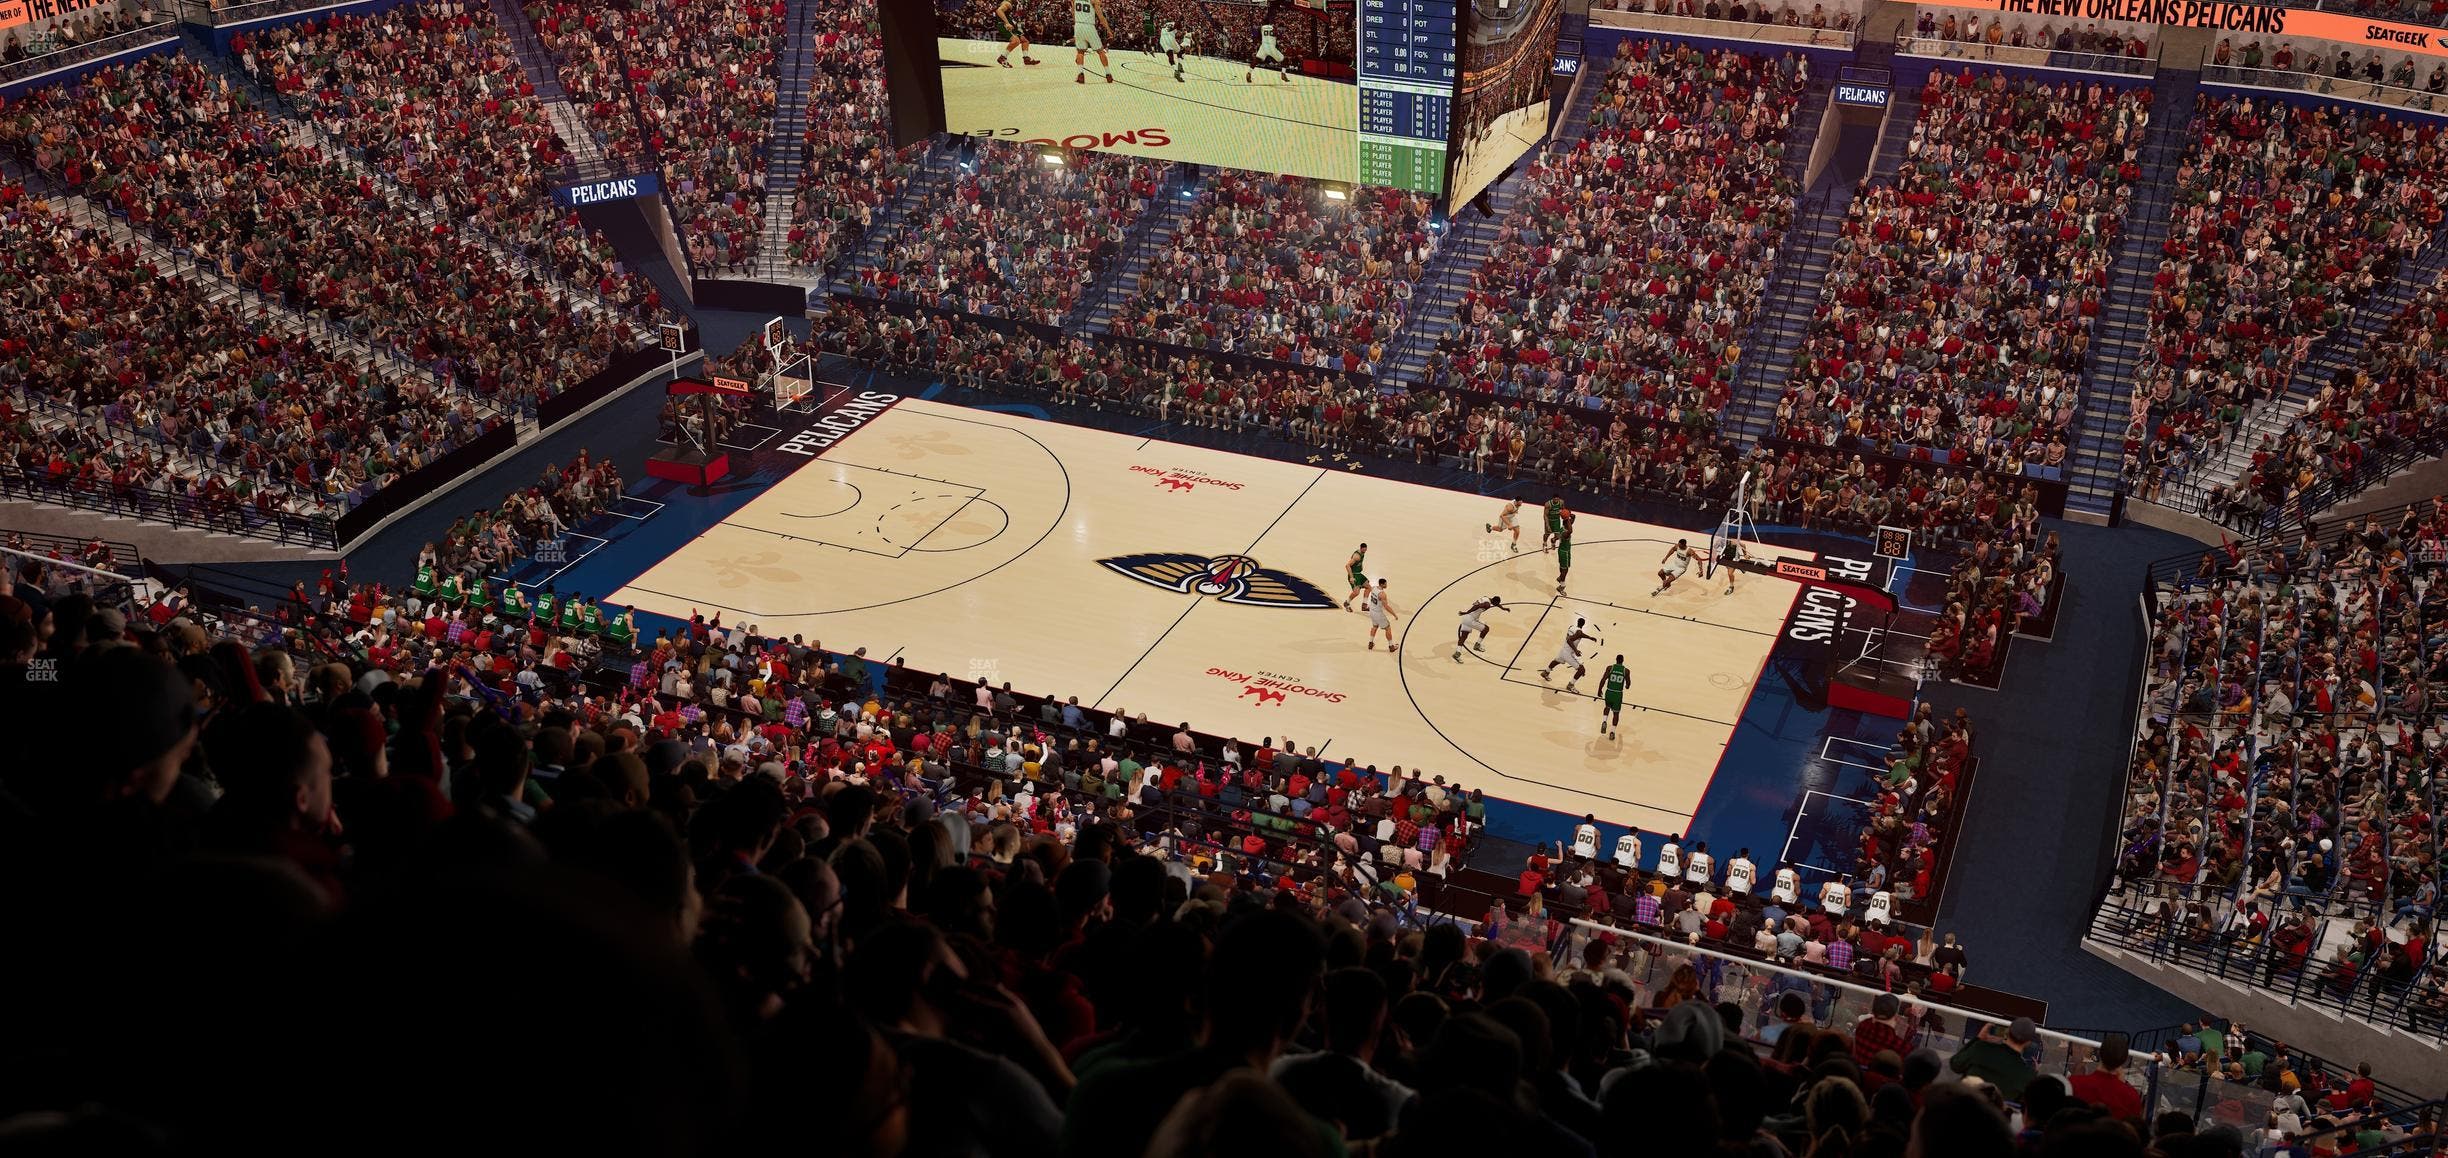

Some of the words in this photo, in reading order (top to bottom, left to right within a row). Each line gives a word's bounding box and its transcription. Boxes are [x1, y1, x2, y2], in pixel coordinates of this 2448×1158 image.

[14, 8, 21, 18] OF
[22, 0, 56, 22] THE
[2087, 0, 2181, 25] ORLEANS
[2183, 0, 2286, 34] PELICANS
[2366, 25, 2429, 48] SEATGEEK
[1840, 87, 1885, 103] PELICANS
[571, 179, 637, 204] PELICANS
[717, 378, 745, 390] SEATGEEK
[776, 391, 898, 457] PELICANS
[1129, 465, 1168, 476] KING
[1168, 473, 1245, 490] SMOOTHIE
[1884, 540, 1900, 555] 88
[1782, 564, 1820, 578] SEATGEEK
[538, 601, 550, 609] 00
[1790, 555, 1873, 644] PEICANS
[1206, 668, 1252, 683] KING
[1258, 670, 1301, 683] CENTER
[1610, 674, 1624, 682] 00
[1254, 677, 1347, 703] SMOOTHIE
[1579, 834, 1593, 844] 00
[1618, 841, 1631, 852] 00
[1661, 854, 1675, 864] 00
[1691, 864, 1706, 874] 00
[1732, 868, 1748, 879] 00
[1777, 880, 1791, 890] 00
[1827, 894, 1843, 905] 00
[1871, 899, 1886, 910] 00
